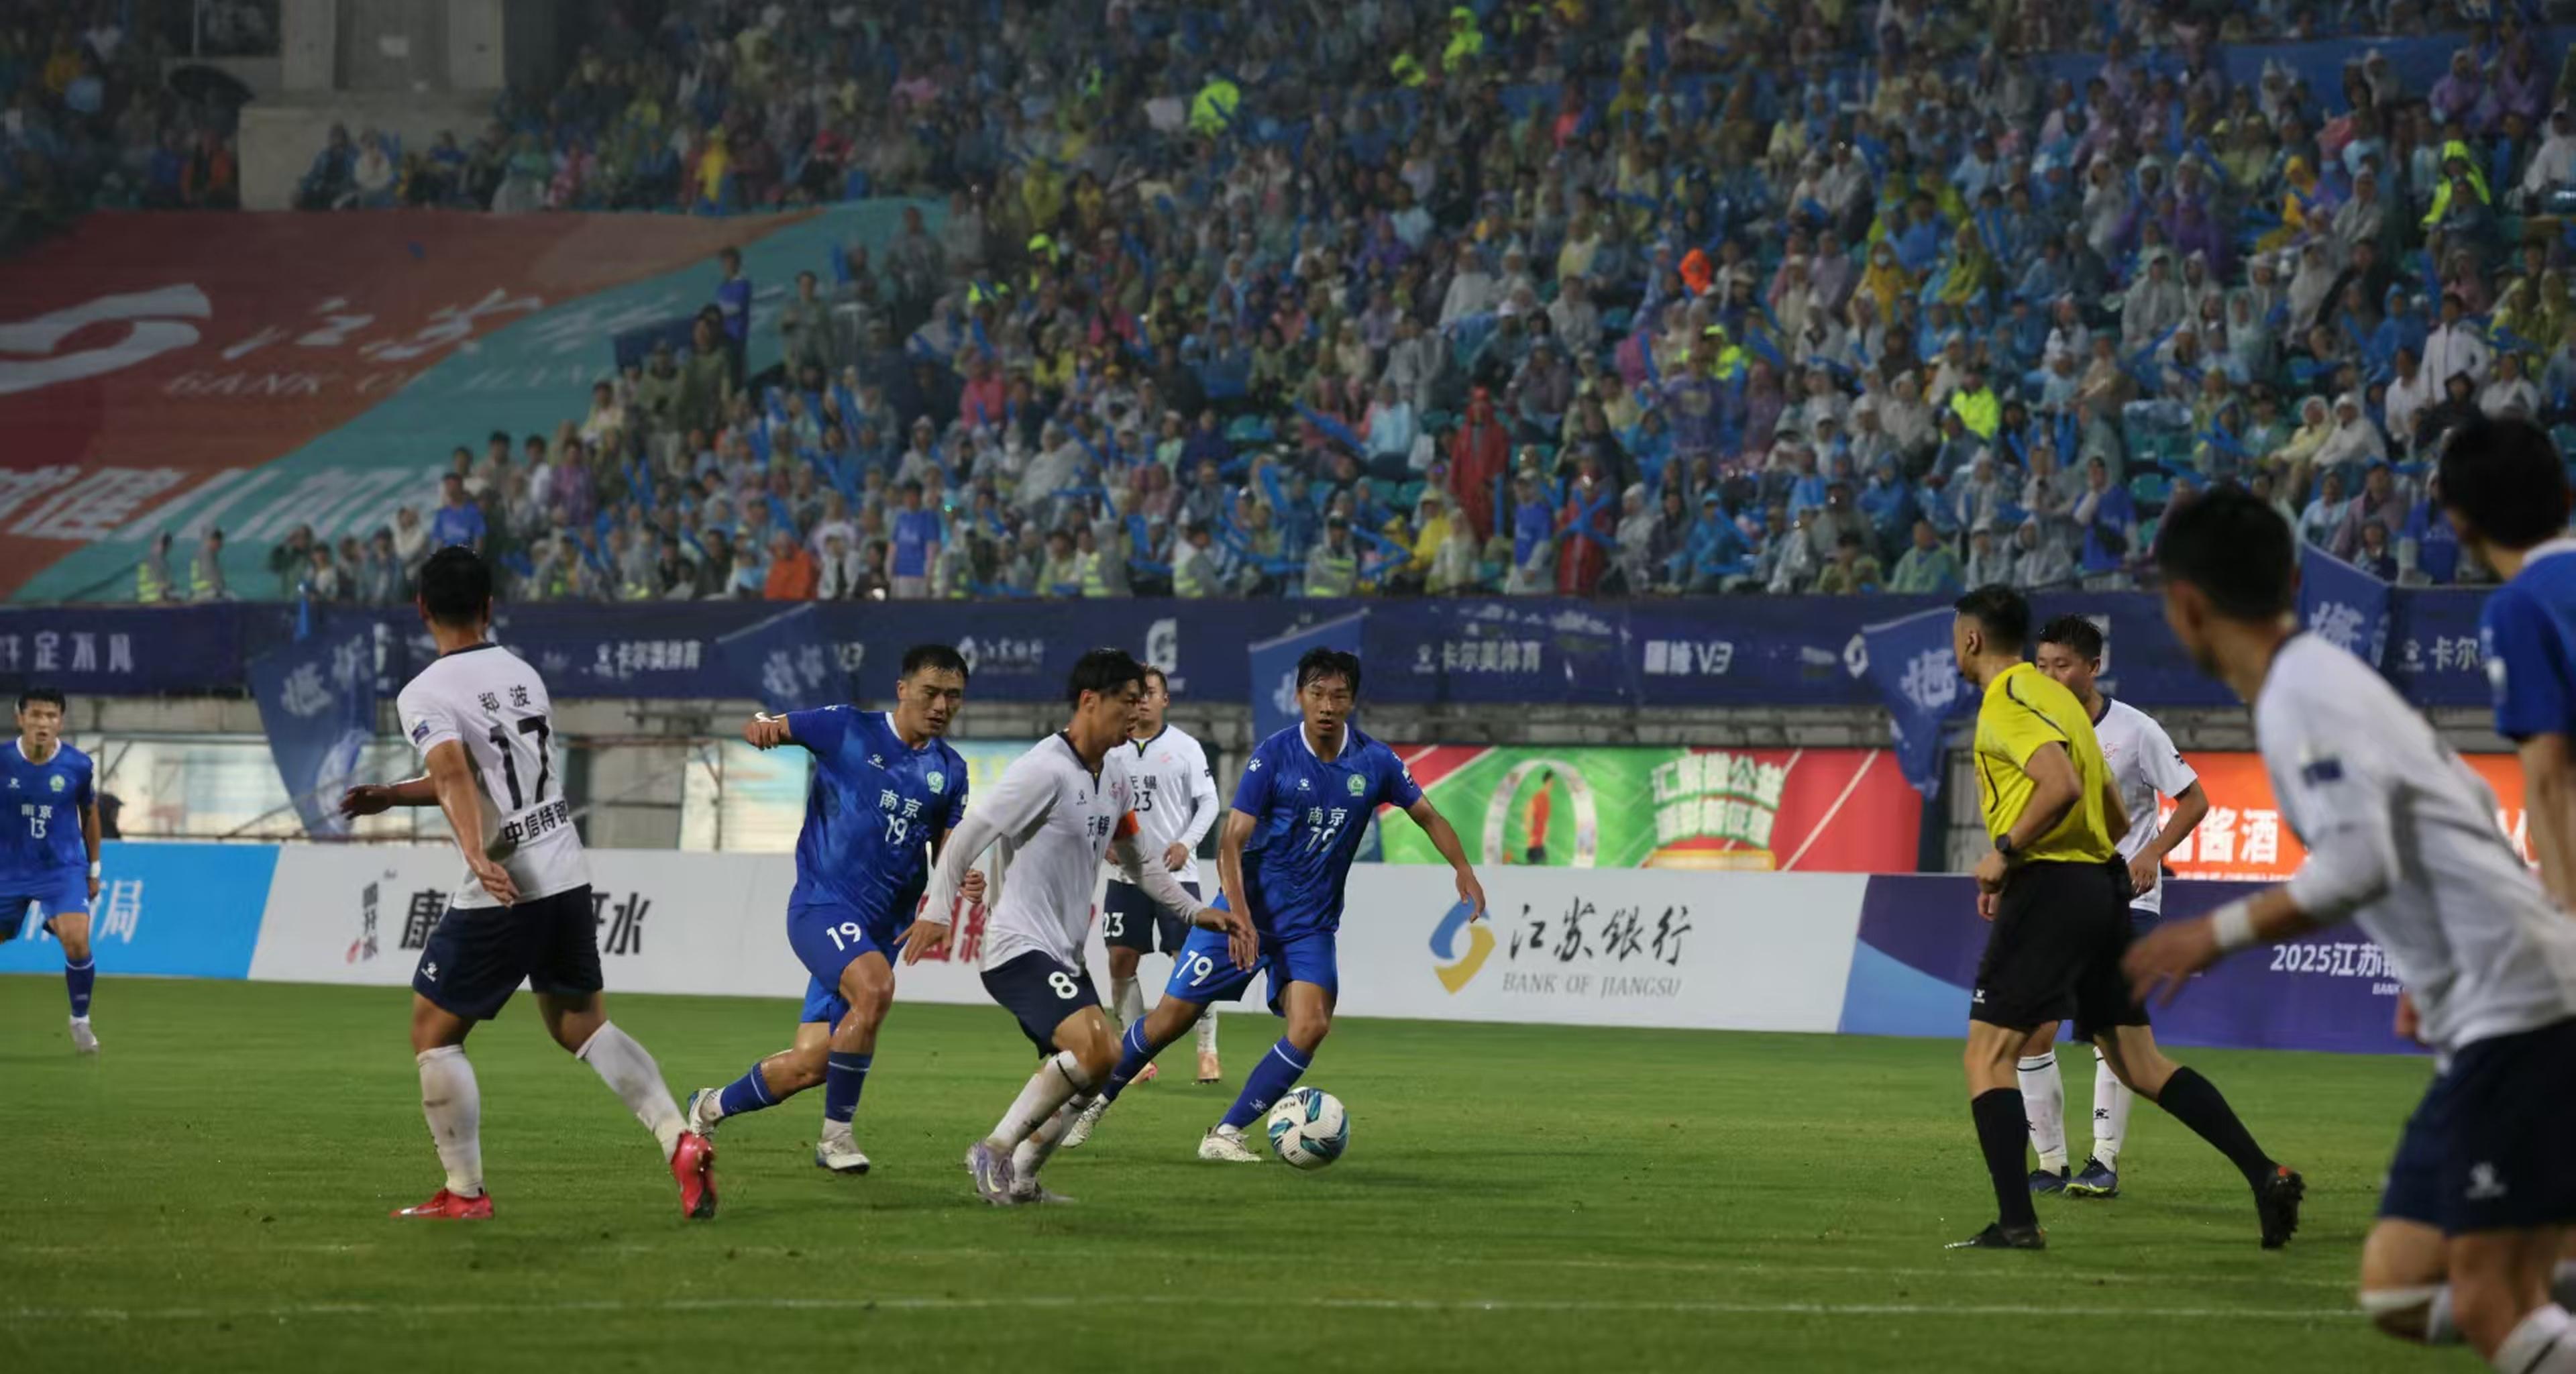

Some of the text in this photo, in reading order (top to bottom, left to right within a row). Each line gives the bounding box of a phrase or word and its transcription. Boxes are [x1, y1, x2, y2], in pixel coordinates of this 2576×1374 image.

[488, 712, 550, 811] 17
[877, 788, 924, 818] 南京
[1133, 789, 1152, 812] 23
[30, 816, 47, 839] 13
[883, 812, 910, 845] 19
[1307, 806, 1348, 826] 南京
[825, 921, 863, 952] 19
[1102, 911, 1125, 938] 23
[1509, 896, 1692, 966] 江苏银行
[1175, 949, 1214, 987] 79
[1048, 971, 1079, 1000] 8
[1502, 973, 1682, 999] BANK OF JIANGSU
